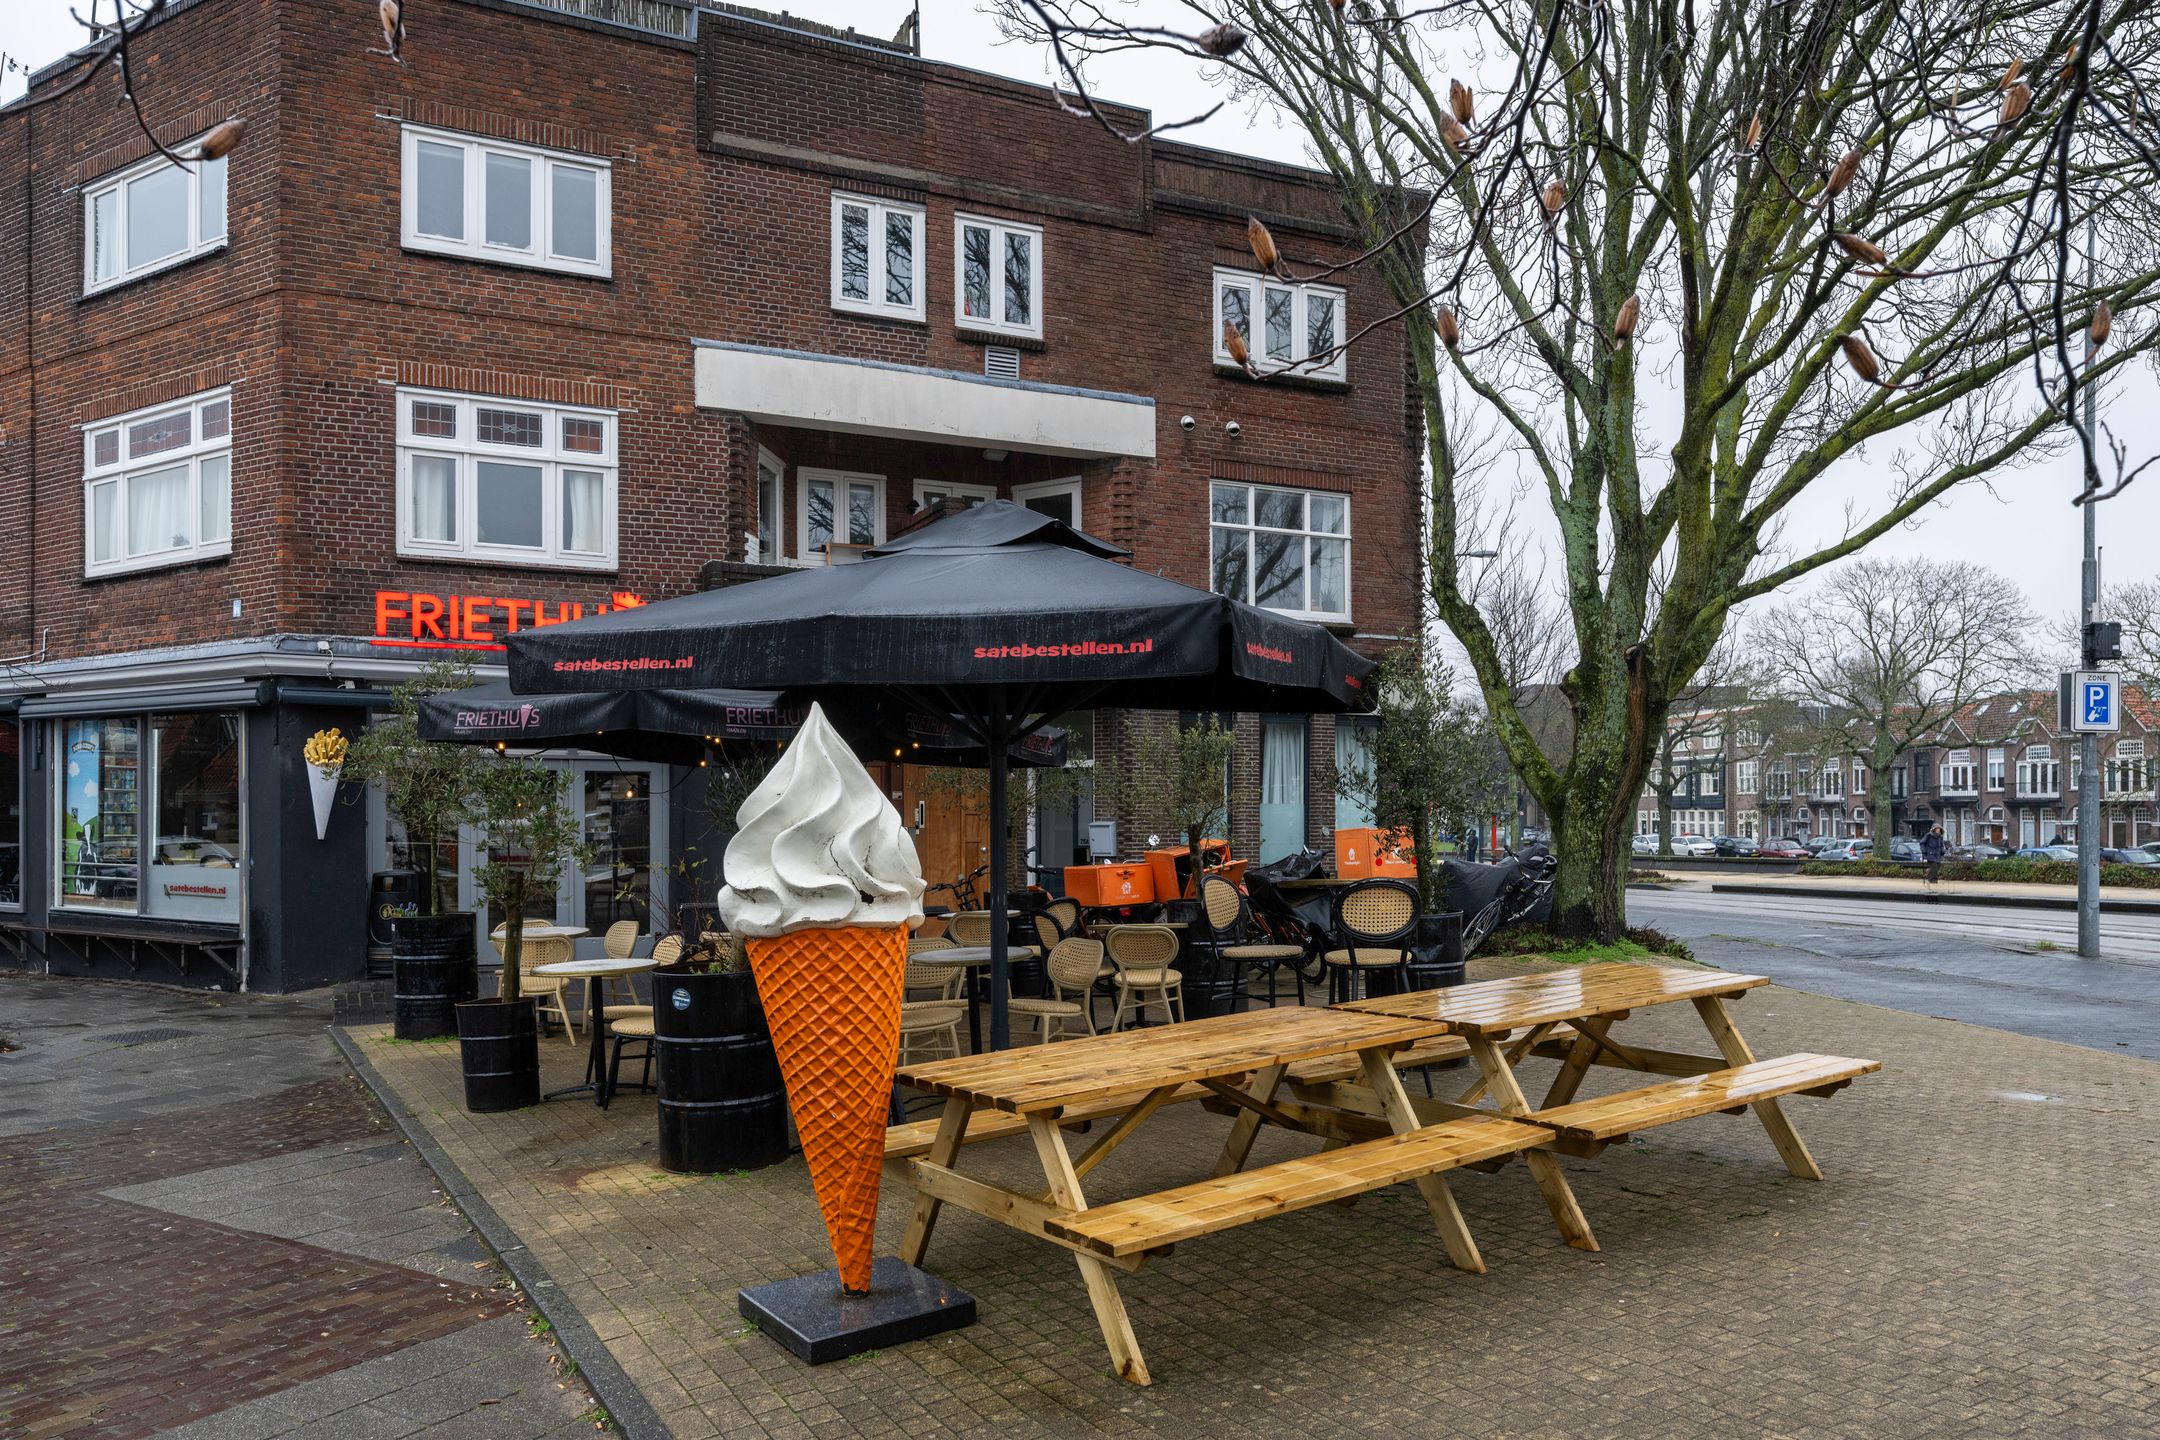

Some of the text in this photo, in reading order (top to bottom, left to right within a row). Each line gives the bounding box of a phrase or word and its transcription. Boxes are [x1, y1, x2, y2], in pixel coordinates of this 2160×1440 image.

[974, 638, 1153, 659] satebestellen.nl
[553, 656, 694, 672] satebestellen.nl
[2090, 686, 2104, 707] P
[169, 884, 226, 895] satebestellen.nl
